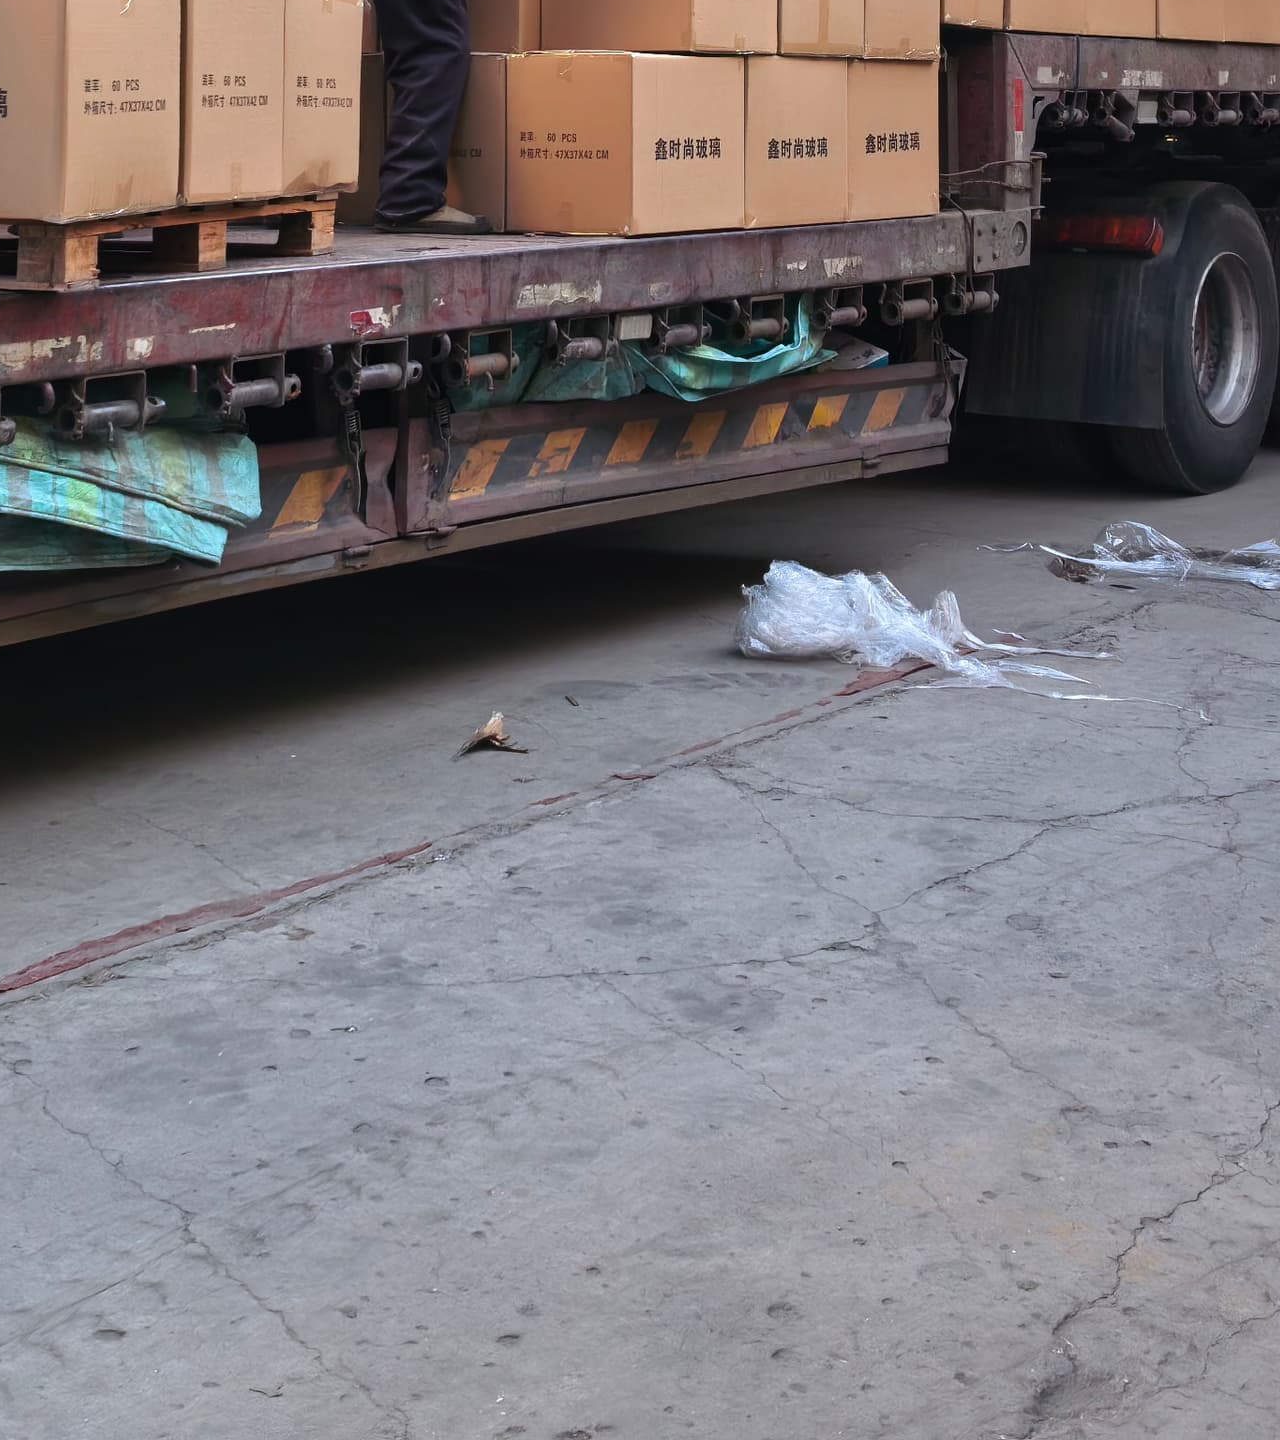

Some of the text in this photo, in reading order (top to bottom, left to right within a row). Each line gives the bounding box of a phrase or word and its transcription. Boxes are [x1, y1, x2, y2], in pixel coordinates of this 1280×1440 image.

[112, 79, 140, 92] 60 PCS
[234, 75, 246, 87] PCS
[326, 78, 336, 89] PCS
[156, 99, 166, 112] CM
[547, 133, 577, 143] 60 PCS
[865, 131, 921, 154] 鑫时尚玻璃
[596, 149, 609, 160] CM
[655, 137, 721, 160] 鑫时尚玻璃
[768, 136, 828, 160] 鑫时尚玻璃
